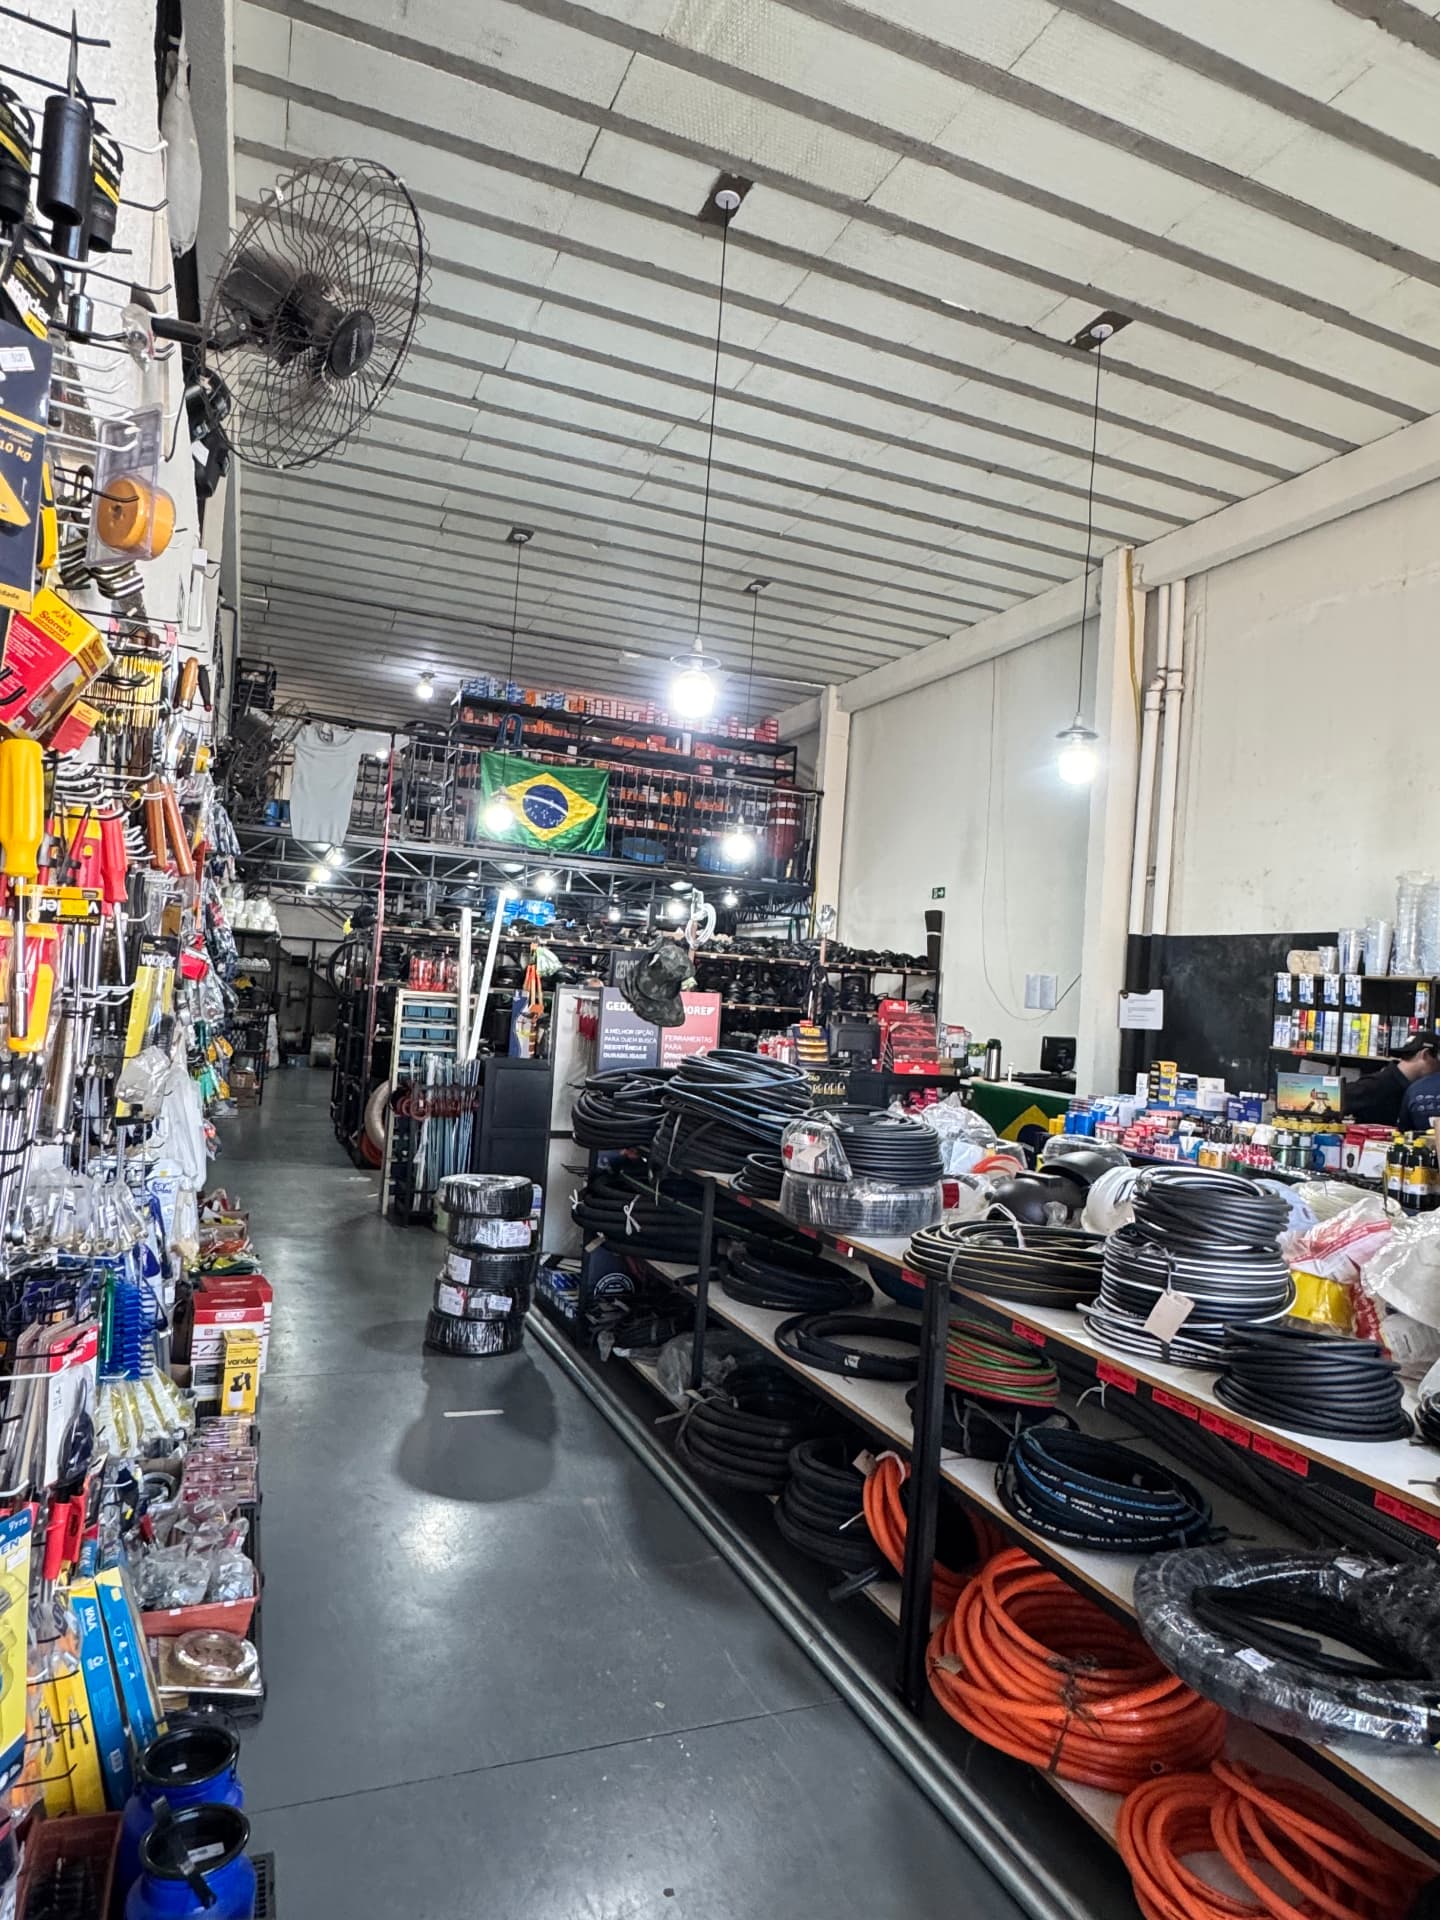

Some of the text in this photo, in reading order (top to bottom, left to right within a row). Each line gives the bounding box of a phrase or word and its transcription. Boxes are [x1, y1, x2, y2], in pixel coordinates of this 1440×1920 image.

[16, 446, 32, 463] kg
[39, 610, 72, 637] Starrett
[38, 898, 99, 915] ver
[605, 1001, 634, 1011] GEDO
[228, 1356, 257, 1365] vonder
